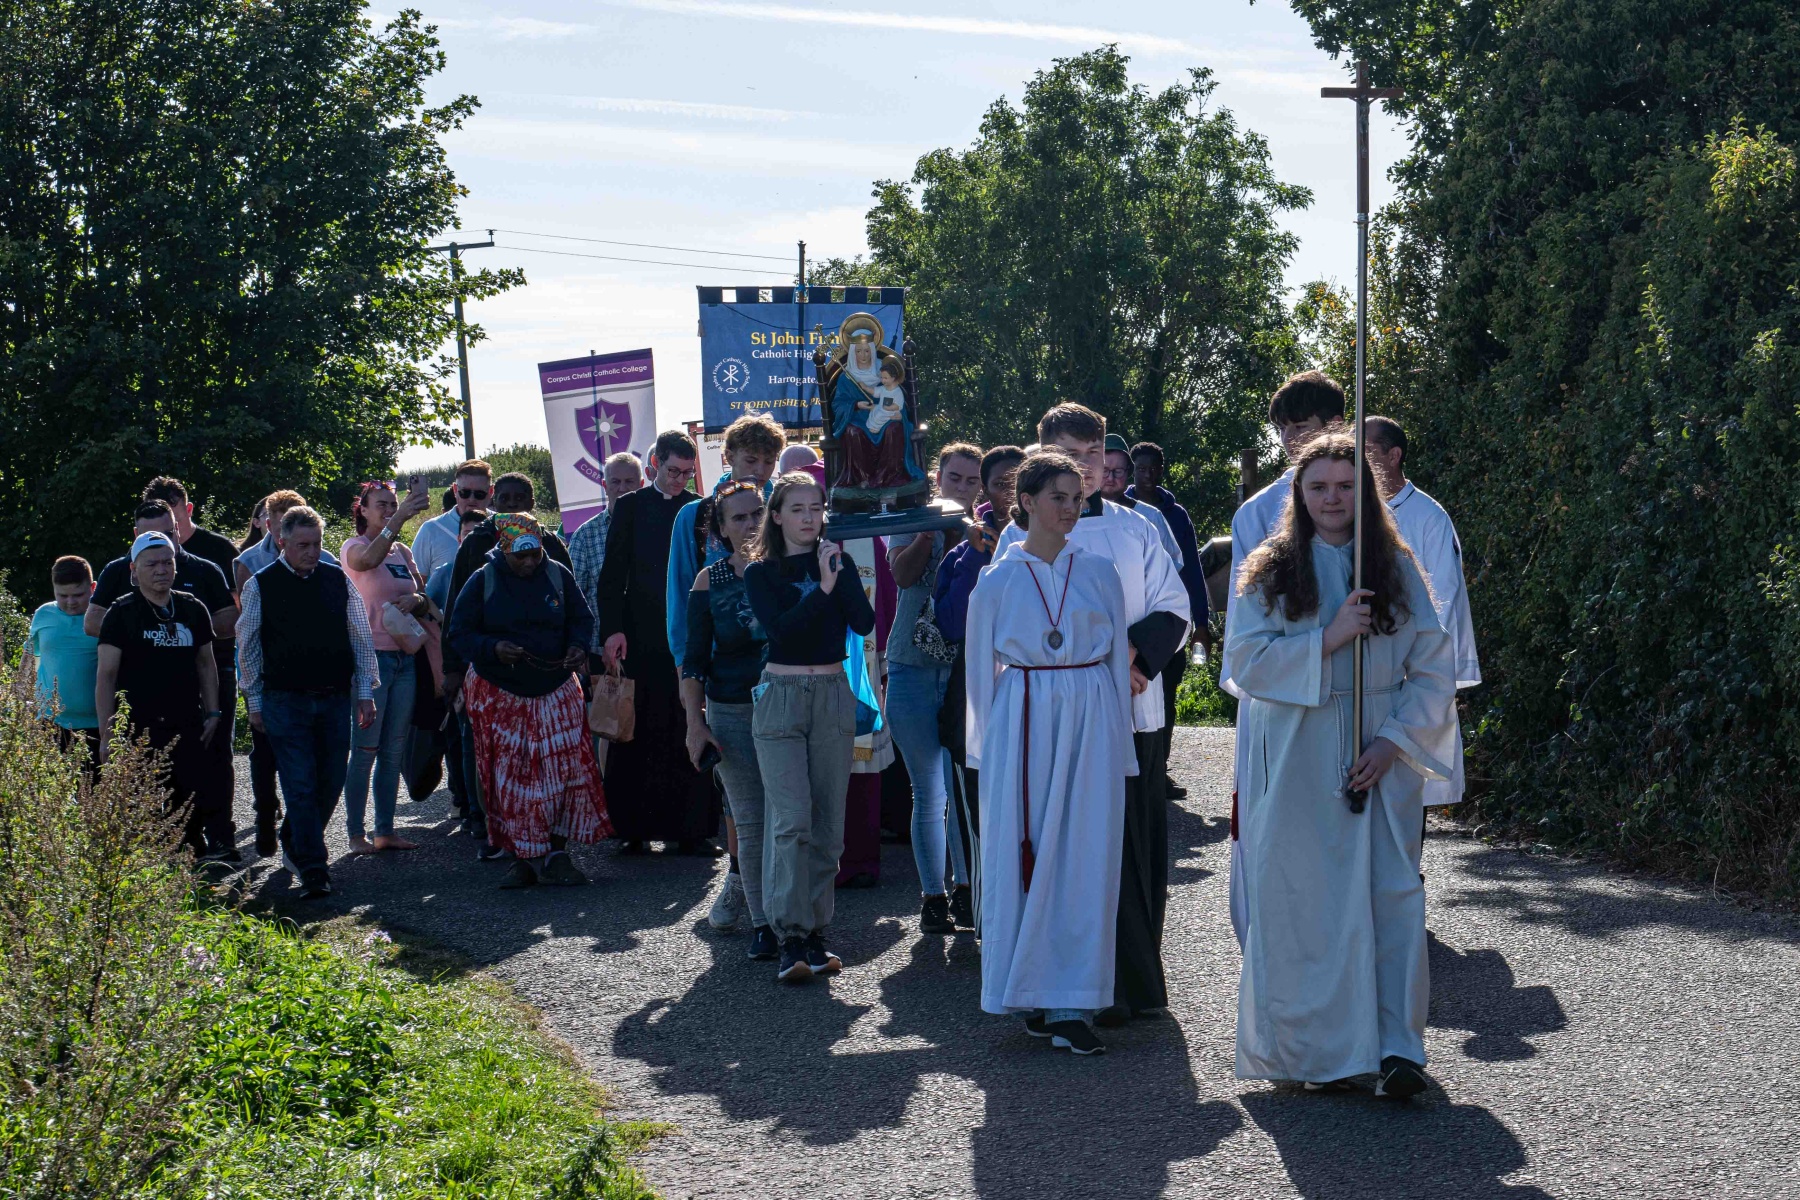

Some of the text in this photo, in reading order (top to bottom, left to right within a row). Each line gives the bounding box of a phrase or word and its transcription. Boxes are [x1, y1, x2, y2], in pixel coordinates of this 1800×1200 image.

[750, 331, 767, 345] St
[770, 331, 805, 348] John
[751, 349, 792, 359] Catholic
[547, 365, 648, 384] Corpus Christi Catholic College
[730, 401, 743, 410] ST
[743, 400, 771, 410] JOHN
[580, 463, 601, 480] CORP
[153, 638, 179, 647] FACE
